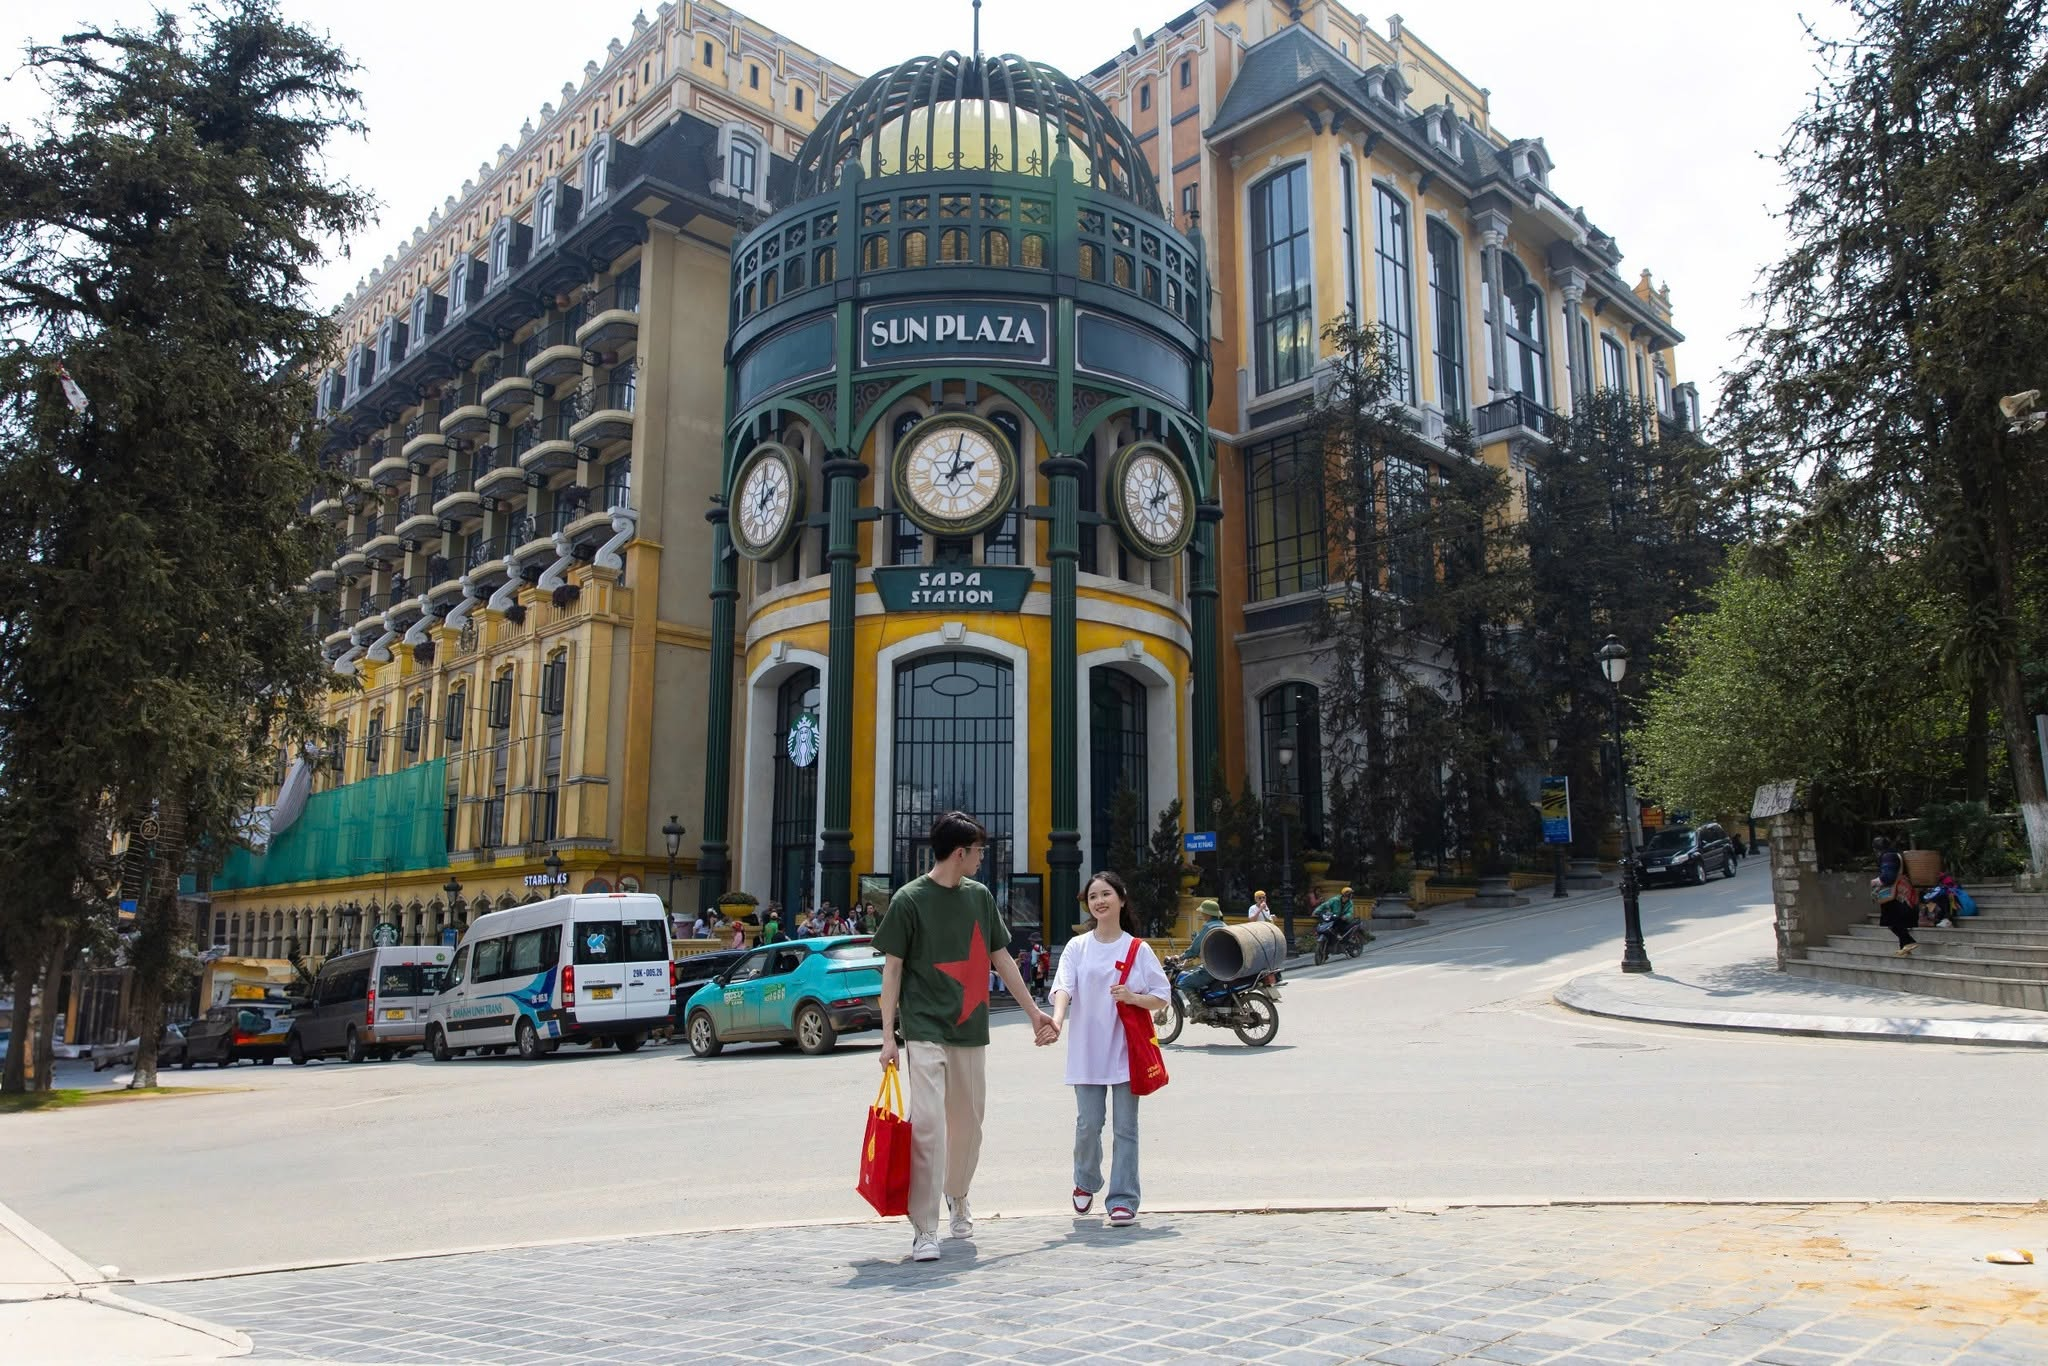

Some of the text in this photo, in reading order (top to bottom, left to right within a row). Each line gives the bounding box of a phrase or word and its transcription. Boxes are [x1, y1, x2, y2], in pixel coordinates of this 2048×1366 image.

[872, 315, 1035, 347] SUN PLAZA
[919, 572, 981, 586] SAPA
[911, 590, 993, 604] STATION
